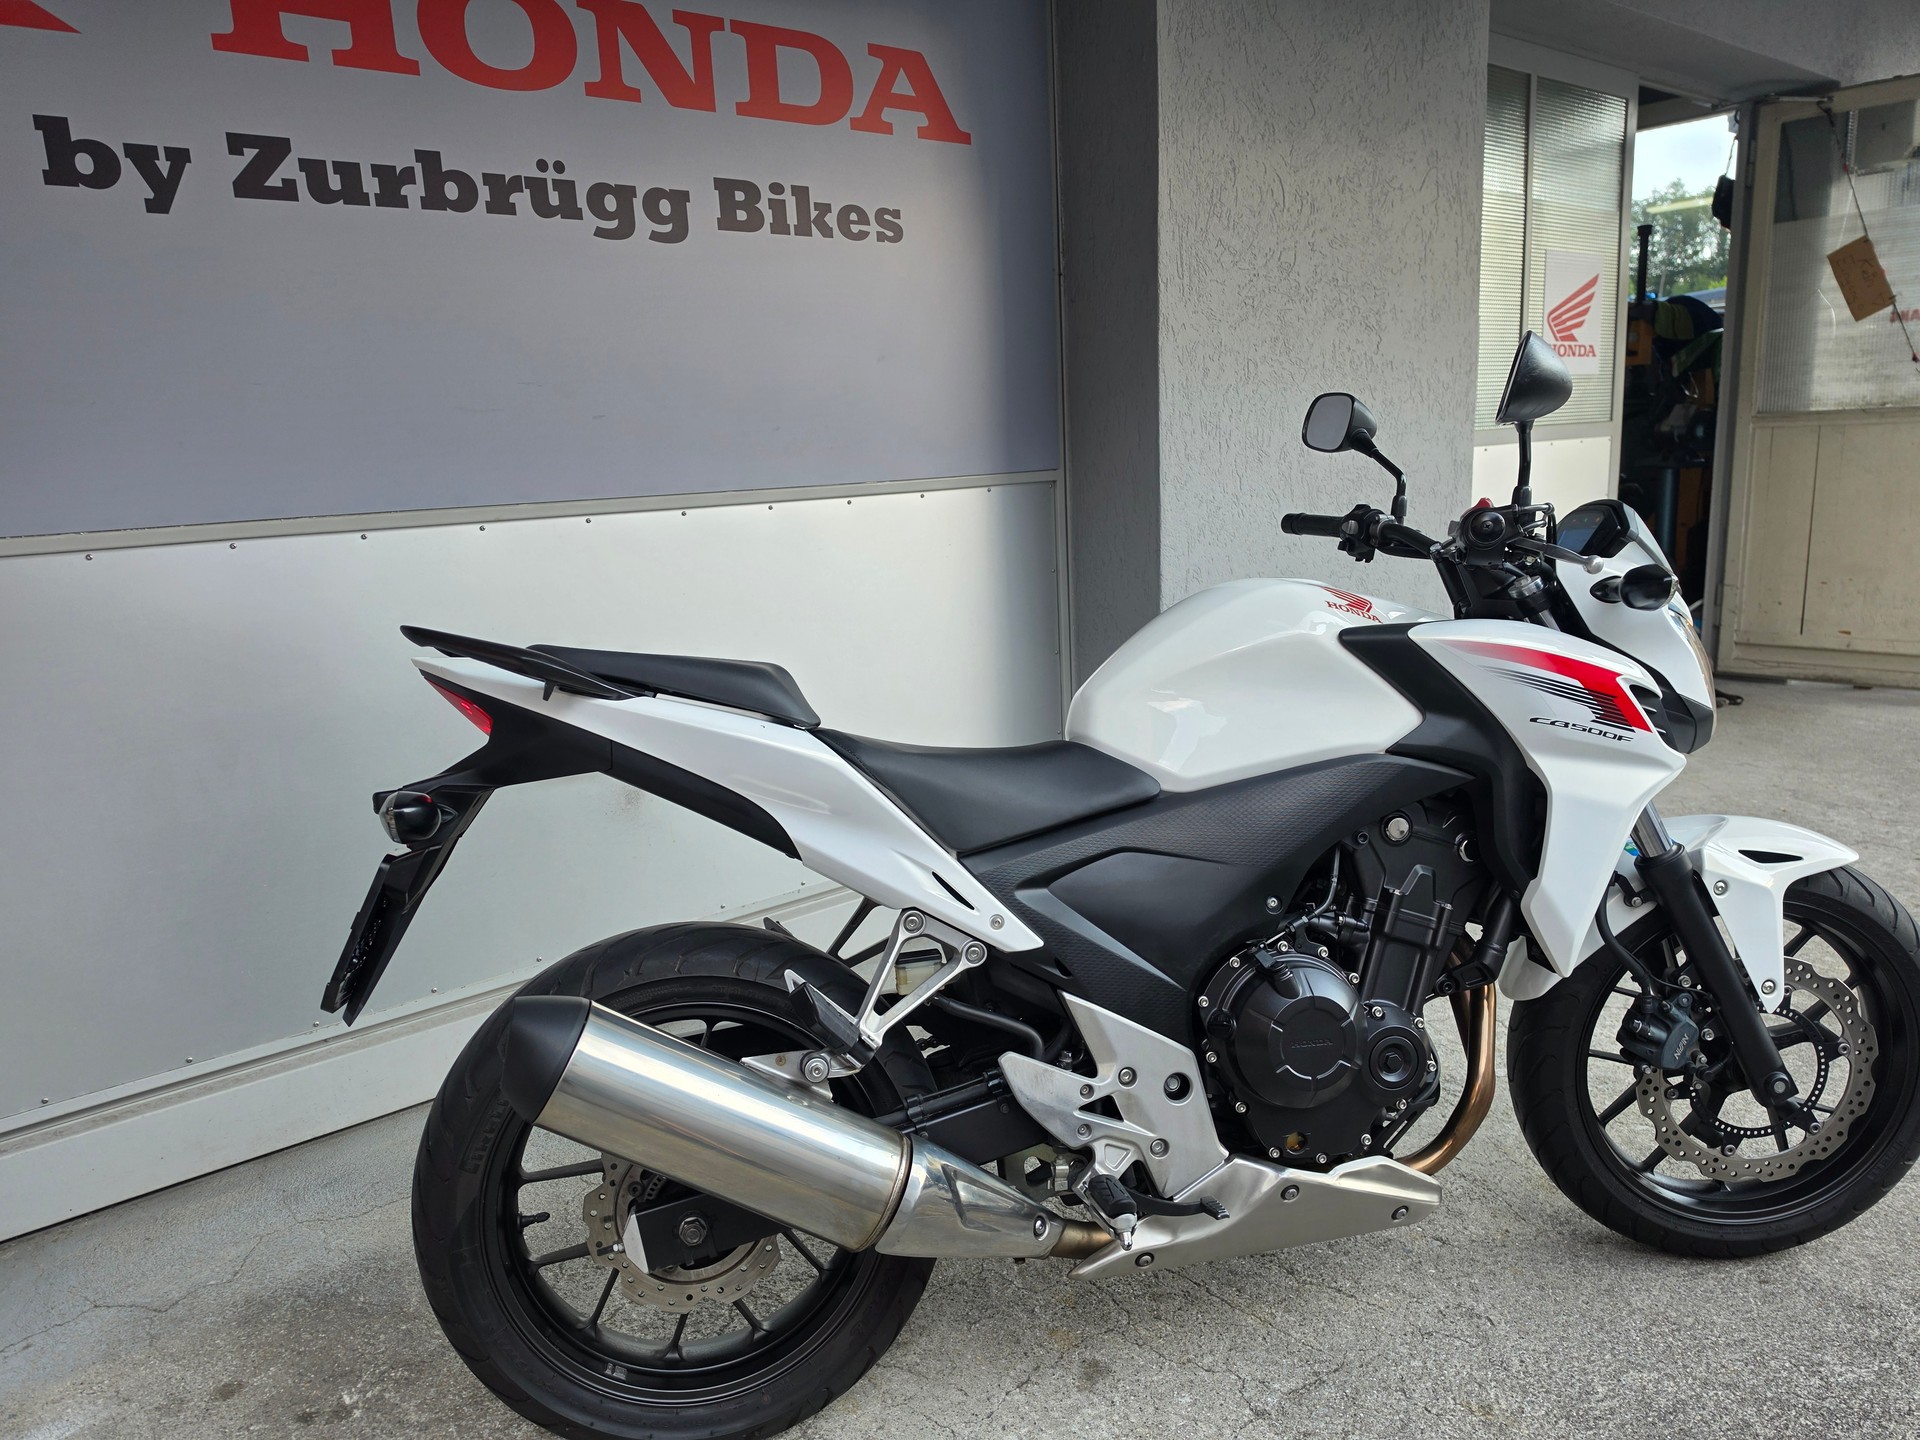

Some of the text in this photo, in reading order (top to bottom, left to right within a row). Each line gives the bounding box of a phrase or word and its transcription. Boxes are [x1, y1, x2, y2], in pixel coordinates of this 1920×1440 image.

[210, 0, 971, 145] HONDA
[32, 114, 904, 244] by Zurbrügg Bikes
[1552, 343, 1597, 358] ONDA
[1325, 600, 1383, 624] HONDA
[1529, 717, 1634, 742] CB500F
